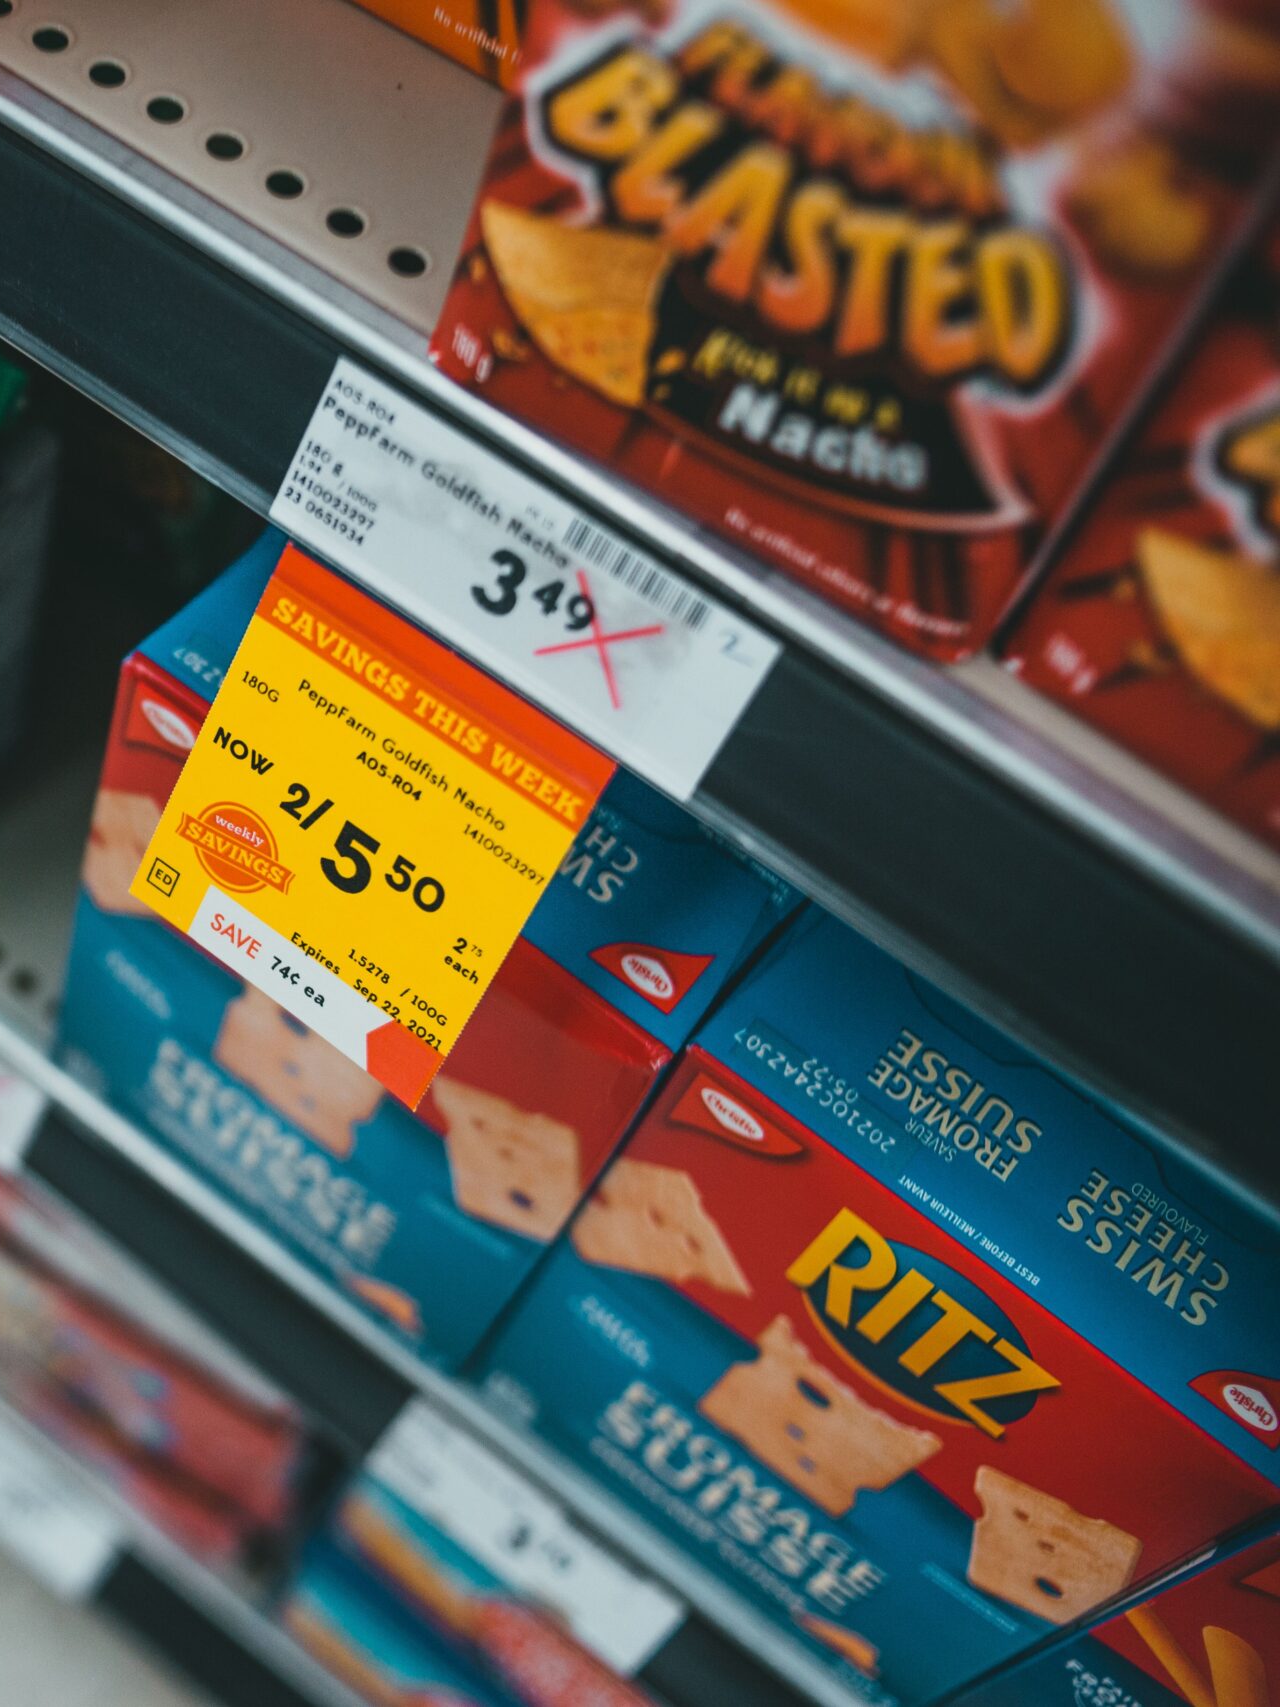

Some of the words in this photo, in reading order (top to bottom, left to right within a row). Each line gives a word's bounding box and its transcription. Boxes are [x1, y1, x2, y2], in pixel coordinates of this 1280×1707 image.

[455, 21, 508, 59] artificial
[551, 48, 1060, 381] BLASTED
[335, 379, 395, 426] A05-R04
[306, 440, 332, 464] 180
[719, 382, 926, 491] Nacho
[292, 470, 375, 530] 1410023297
[323, 395, 415, 467] PeppFarm
[421, 460, 501, 525] Goldfish
[507, 517, 568, 568] Nacho
[285, 487, 302, 504] 23
[306, 501, 364, 545] 0651934
[471, 548, 527, 617] 3
[532, 581, 595, 632] 49
[241, 671, 280, 703] 180G
[272, 597, 410, 702] SAVINGS
[413, 688, 487, 755] THIS
[490, 741, 583, 823] WEEK
[213, 726, 275, 777] NOW
[298, 679, 377, 743] PeppFarm
[382, 738, 449, 792] Goldfish
[453, 787, 507, 832] Nacho
[356, 750, 423, 803] A05-R04
[186, 822, 284, 884] SAVINGS
[215, 815, 265, 847] weekly
[280, 782, 334, 831] 2/
[320, 820, 381, 894] 5
[384, 854, 446, 913] 50
[463, 823, 546, 887] 1410023297
[152, 867, 173, 887] ED
[210, 913, 262, 960] SAVE
[270, 956, 301, 985] 74¢
[304, 985, 325, 1007] ea
[444, 955, 479, 984] each
[452, 937, 468, 954] 2
[471, 944, 483, 958] 75
[628, 957, 668, 992] Christie
[290, 931, 340, 975] Expires
[353, 978, 378, 1003] Sep
[381, 1000, 401, 1023] 22,
[408, 1019, 442, 1051] 2021
[348, 949, 390, 984] 1.5278
[411, 995, 448, 1026] 100G
[868, 1058, 1019, 1182] FROMAGE
[888, 1029, 1042, 1154] SUISSE
[905, 1117, 957, 1162] SAVEUR
[898, 1175, 931, 1202] AVANT
[930, 1198, 975, 1237] MEILLEUR
[1131, 1182, 1209, 1246] FLAVOURED
[979, 1236, 1014, 1270] BEFORE
[1081, 1168, 1229, 1291] CHEESE
[1013, 1262, 1040, 1286] BEST
[1057, 1197, 1218, 1326] SWISS
[785, 1207, 1062, 1440] RITZ
[1230, 1386, 1274, 1427] Christie
[598, 1400, 850, 1616] SUISSE
[618, 1380, 888, 1592] FROMAGE
